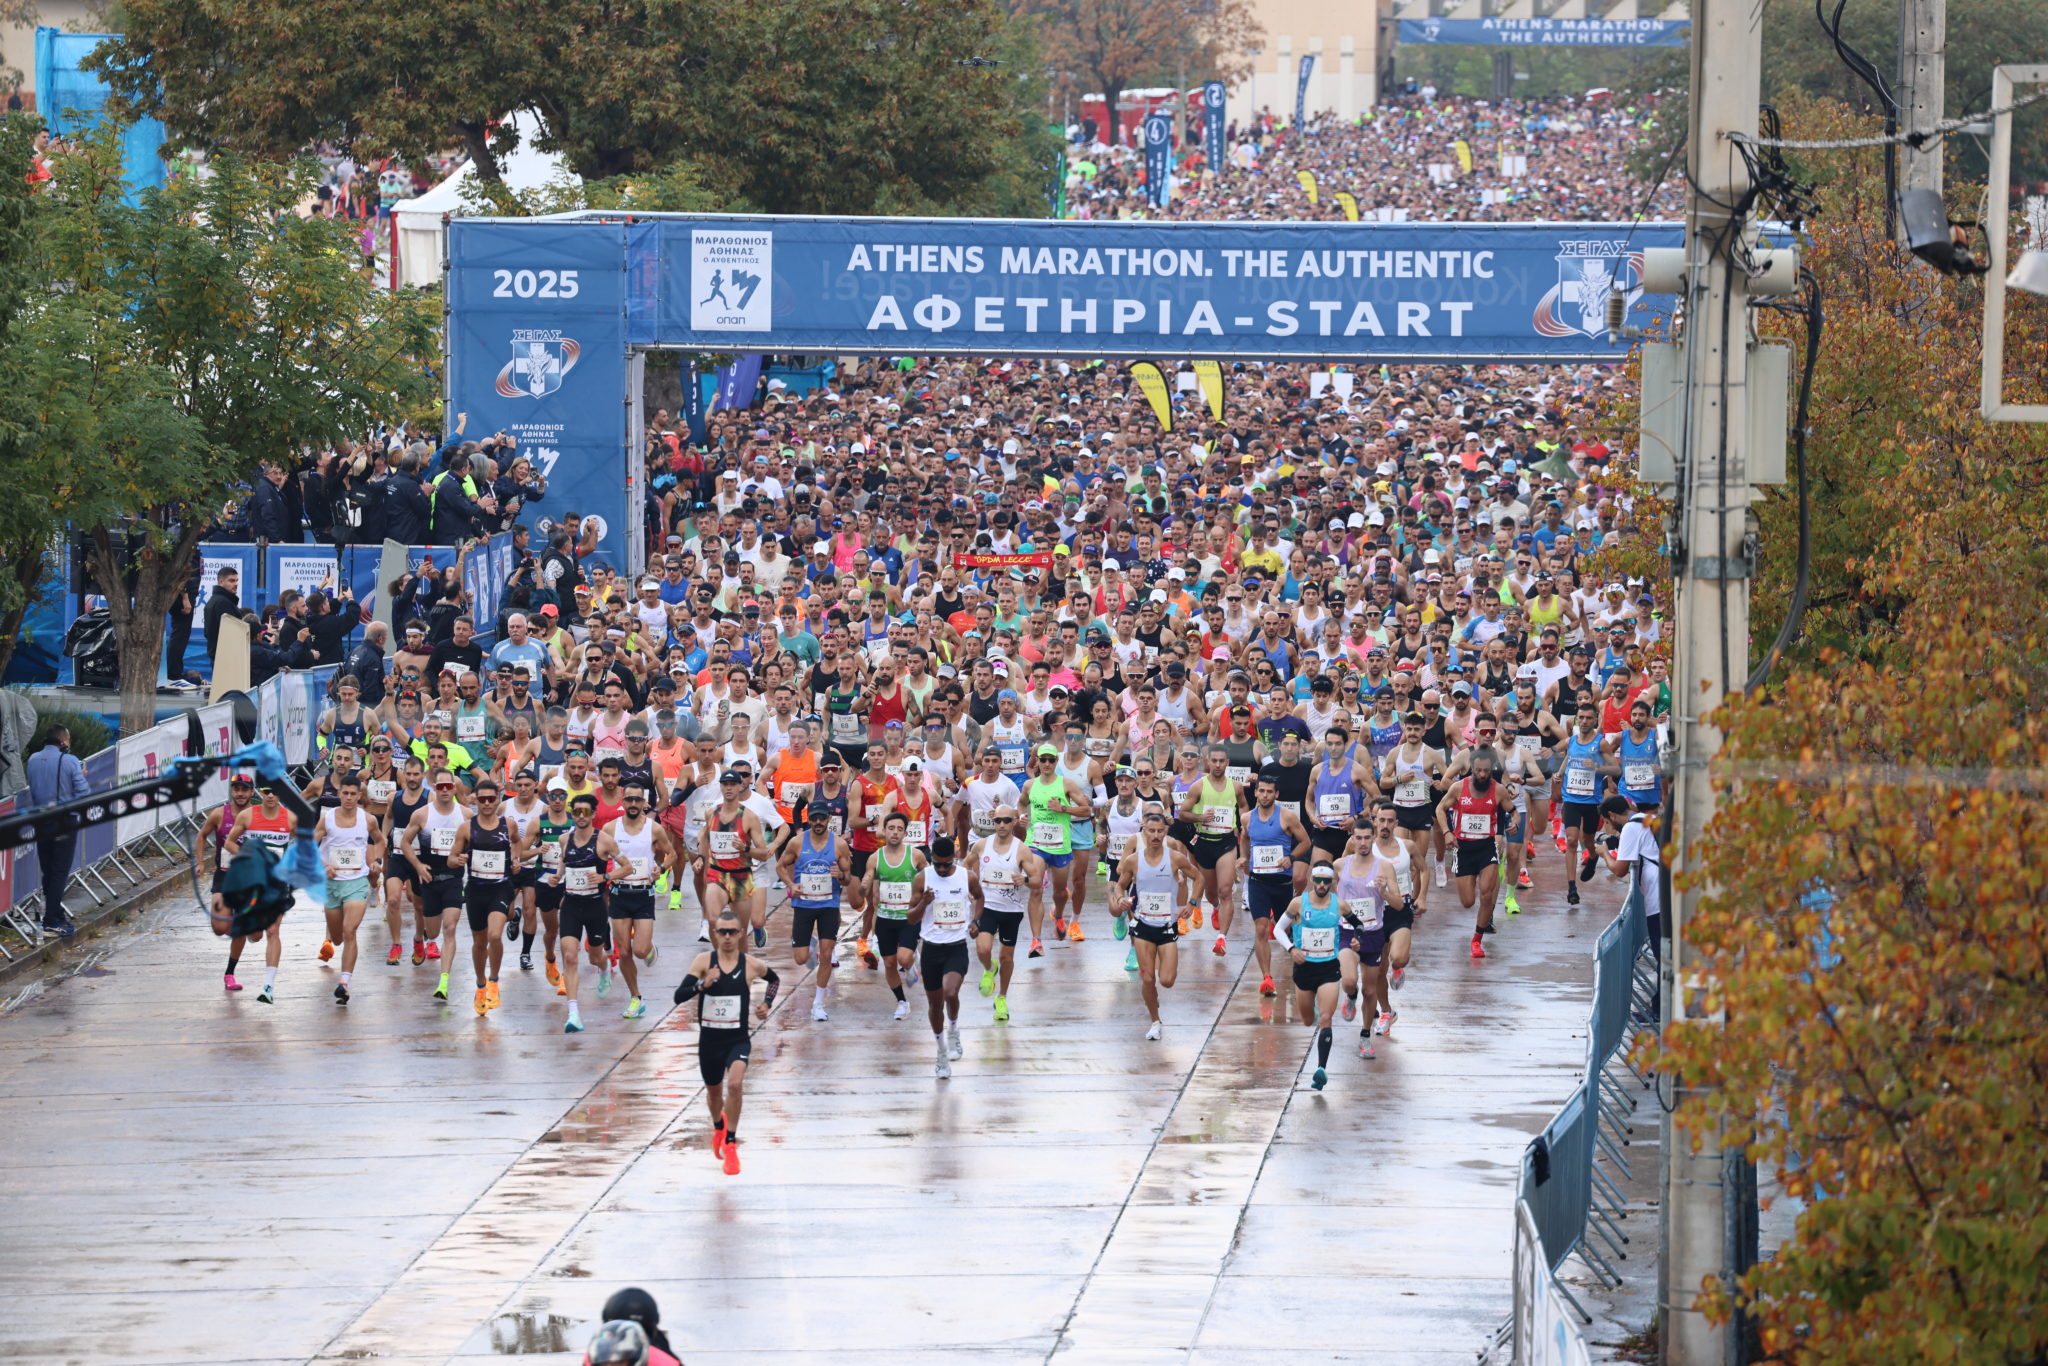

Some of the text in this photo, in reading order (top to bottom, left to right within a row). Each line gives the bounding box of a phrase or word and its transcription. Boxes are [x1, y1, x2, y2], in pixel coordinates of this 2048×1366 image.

[1483, 19, 1664, 31] ATHENS MARATHON
[1500, 32, 1645, 43] THE AUTHENTIC
[695, 236, 768, 246] ΜΑΡΑΘΩΝΙΟΣ
[709, 247, 754, 256] ΑΘΗΝΑΣ
[1558, 240, 1630, 256] ΣΕΓΑΣ
[847, 244, 1493, 278] ATHENS MARATHON. THE AUTHENTIC
[493, 269, 578, 298] 2025
[513, 329, 563, 341] ΣΕΓΑΣ
[1570, 778, 1591, 786] 21437
[1043, 832, 1053, 840] 79
[888, 892, 902, 900] 614
[1149, 903, 1159, 911] 29
[715, 1008, 726, 1017] 32
